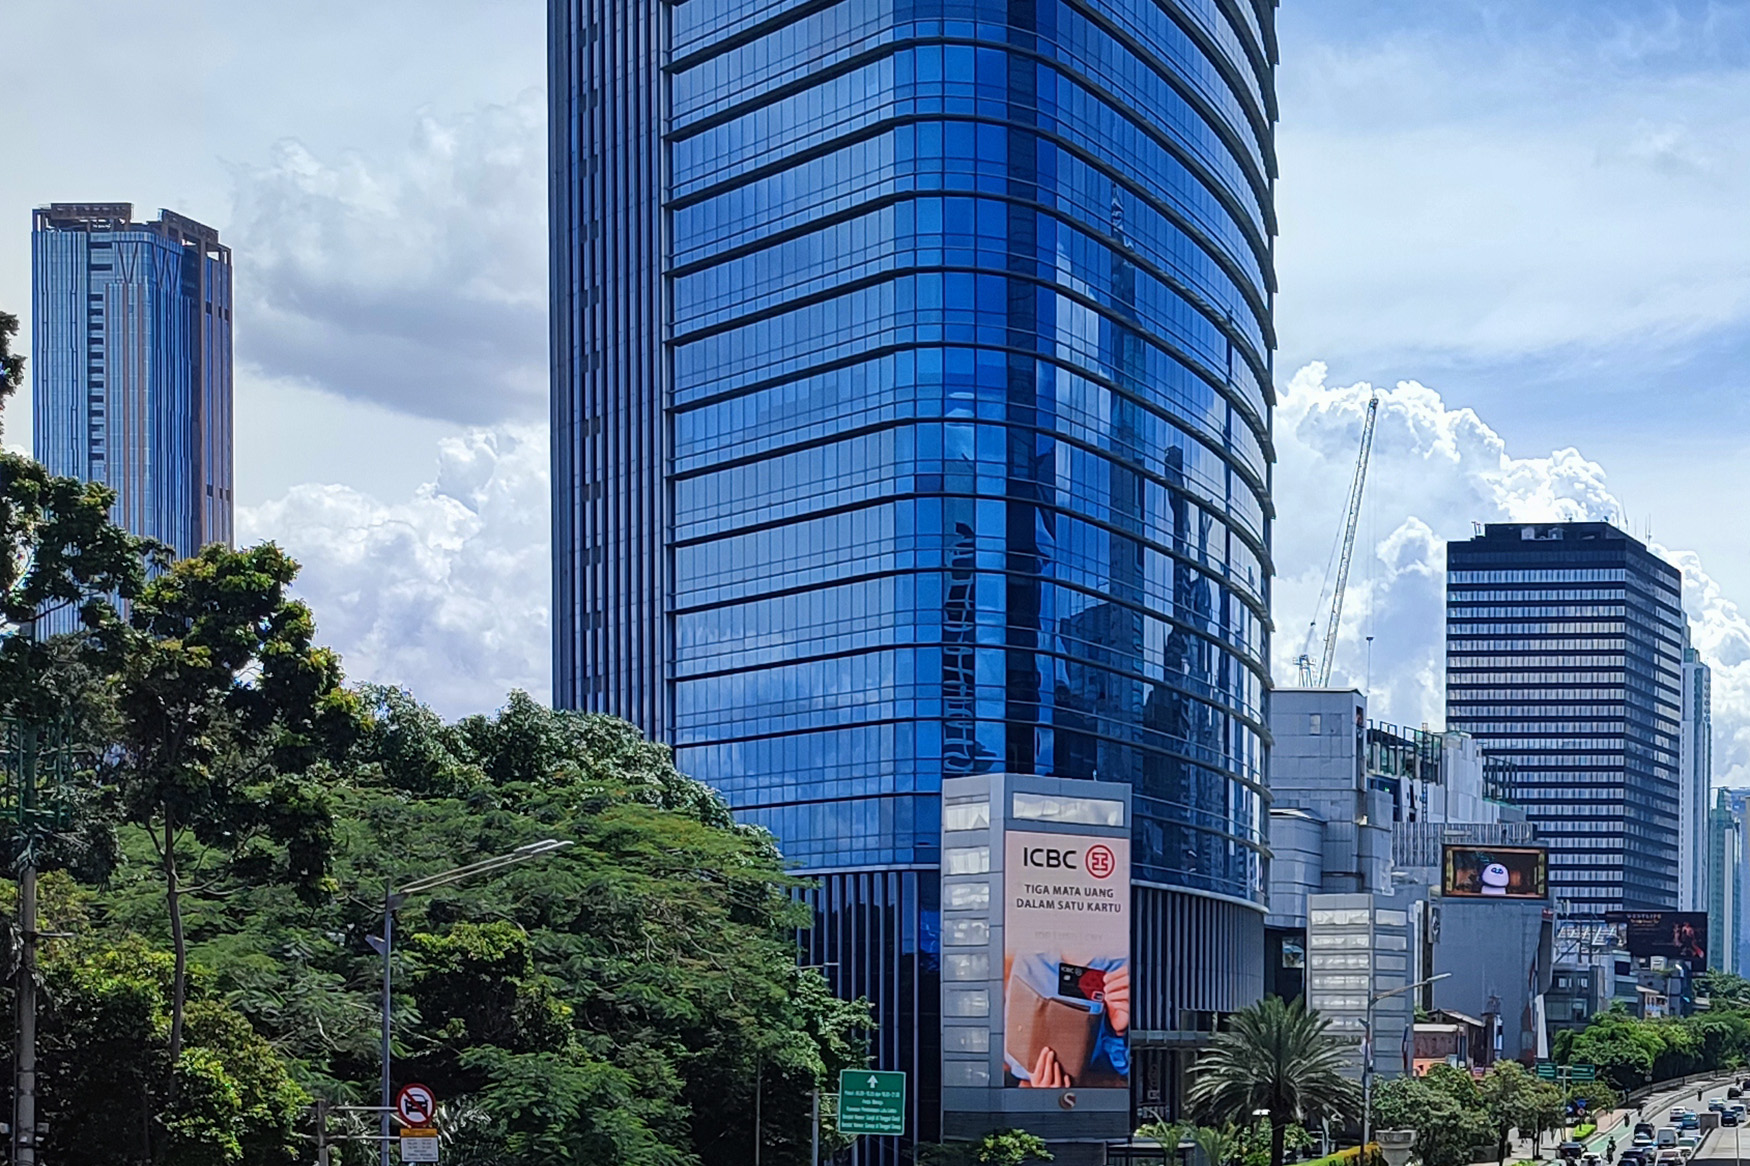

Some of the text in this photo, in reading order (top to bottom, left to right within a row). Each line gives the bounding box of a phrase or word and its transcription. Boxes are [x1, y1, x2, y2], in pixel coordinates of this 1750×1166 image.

[1023, 847, 1077, 869] ICBC
[1024, 884, 1114, 898] TIGA MATA UANG
[1016, 898, 1121, 913] DALAM SATU KARTU
